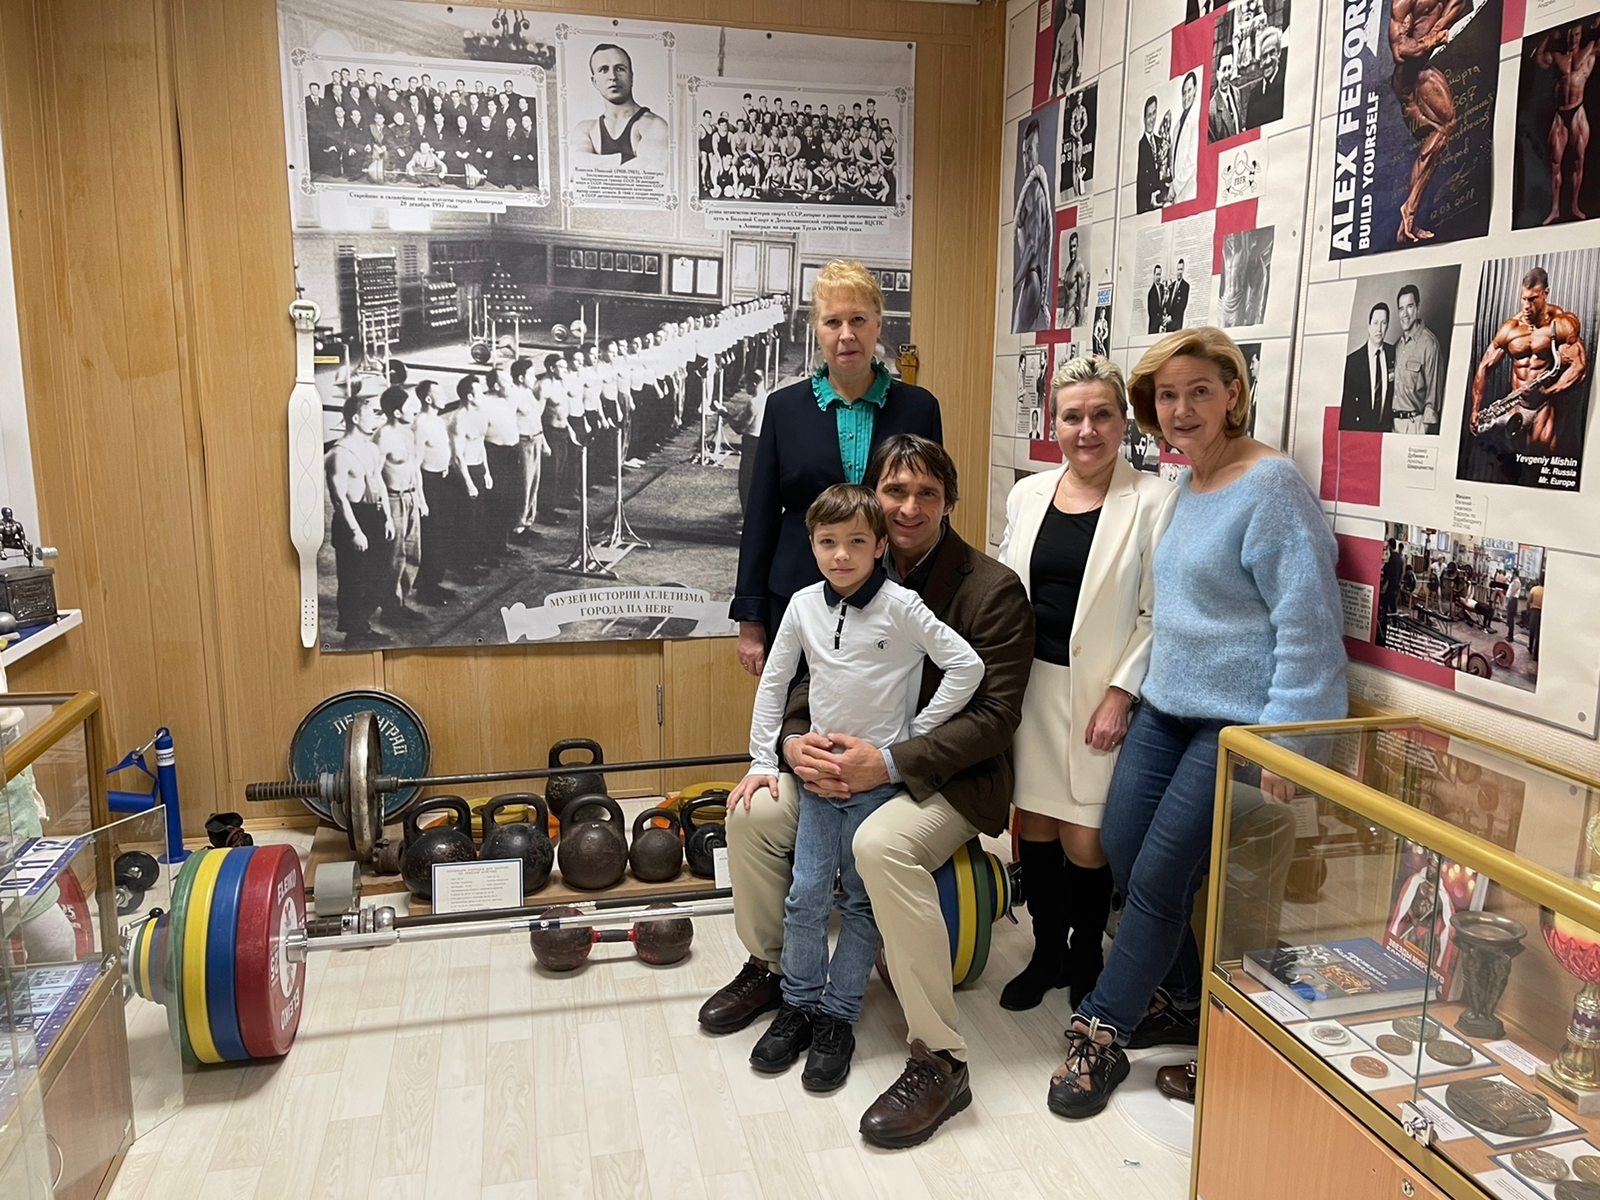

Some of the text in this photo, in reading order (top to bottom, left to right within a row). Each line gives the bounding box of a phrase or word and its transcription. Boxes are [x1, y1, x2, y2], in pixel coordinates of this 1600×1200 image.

[1332, 0, 1368, 252] ALEX FEDOR
[1359, 91, 1380, 250] BUILD YOURSELF
[1516, 453, 1578, 467] Yevgeniy Mishin
[1541, 466, 1577, 477] Mr. Russia
[1538, 476, 1576, 488] Mr. Europe
[550, 590, 705, 608] МУЗЕЙ ИСТОРИИ АТЛЕТИЗМА
[580, 604, 674, 617] ГОРОДА НА НЕВЕ
[333, 713, 408, 756] ЛЕНГРАД
